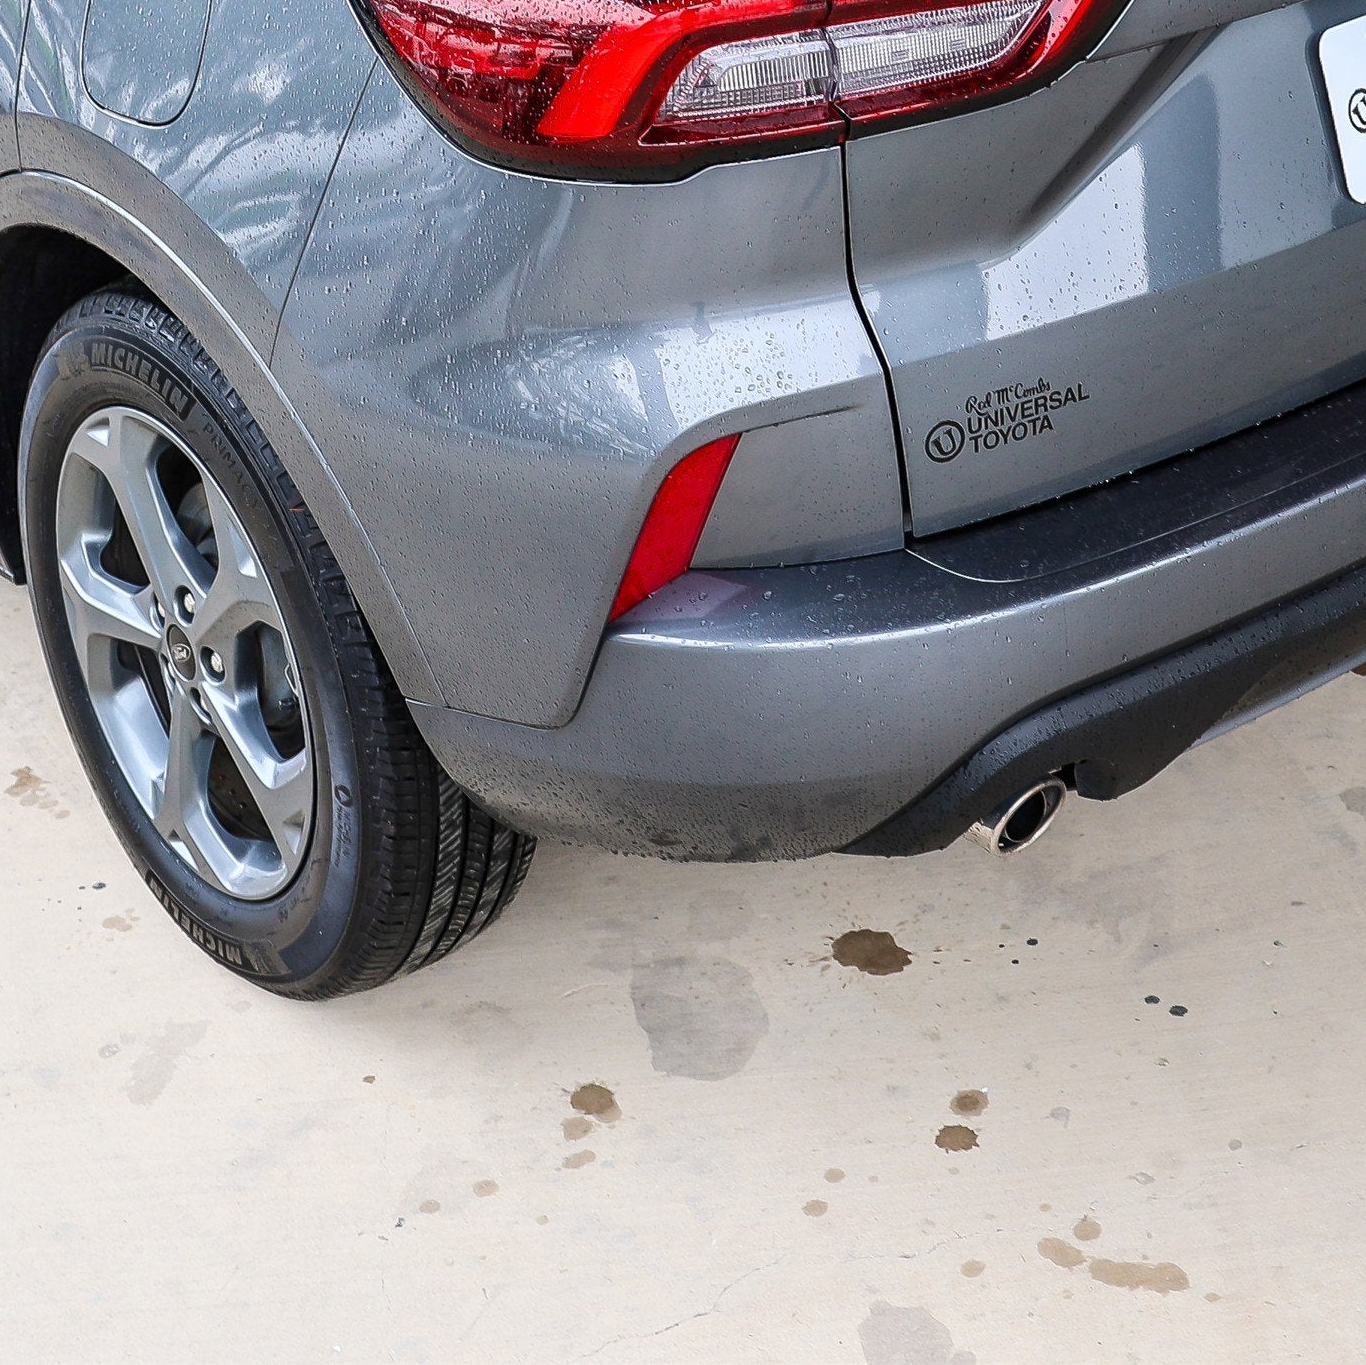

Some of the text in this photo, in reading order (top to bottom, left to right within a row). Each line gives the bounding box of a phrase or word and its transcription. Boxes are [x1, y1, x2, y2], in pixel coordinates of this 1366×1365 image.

[91, 341, 189, 414] MICHELIN
[965, 377, 1051, 417] Red McCombs
[966, 382, 1091, 435] UNIVERSAL
[968, 414, 1054, 454] TOYOTA
[148, 877, 243, 966] MICHELIN
